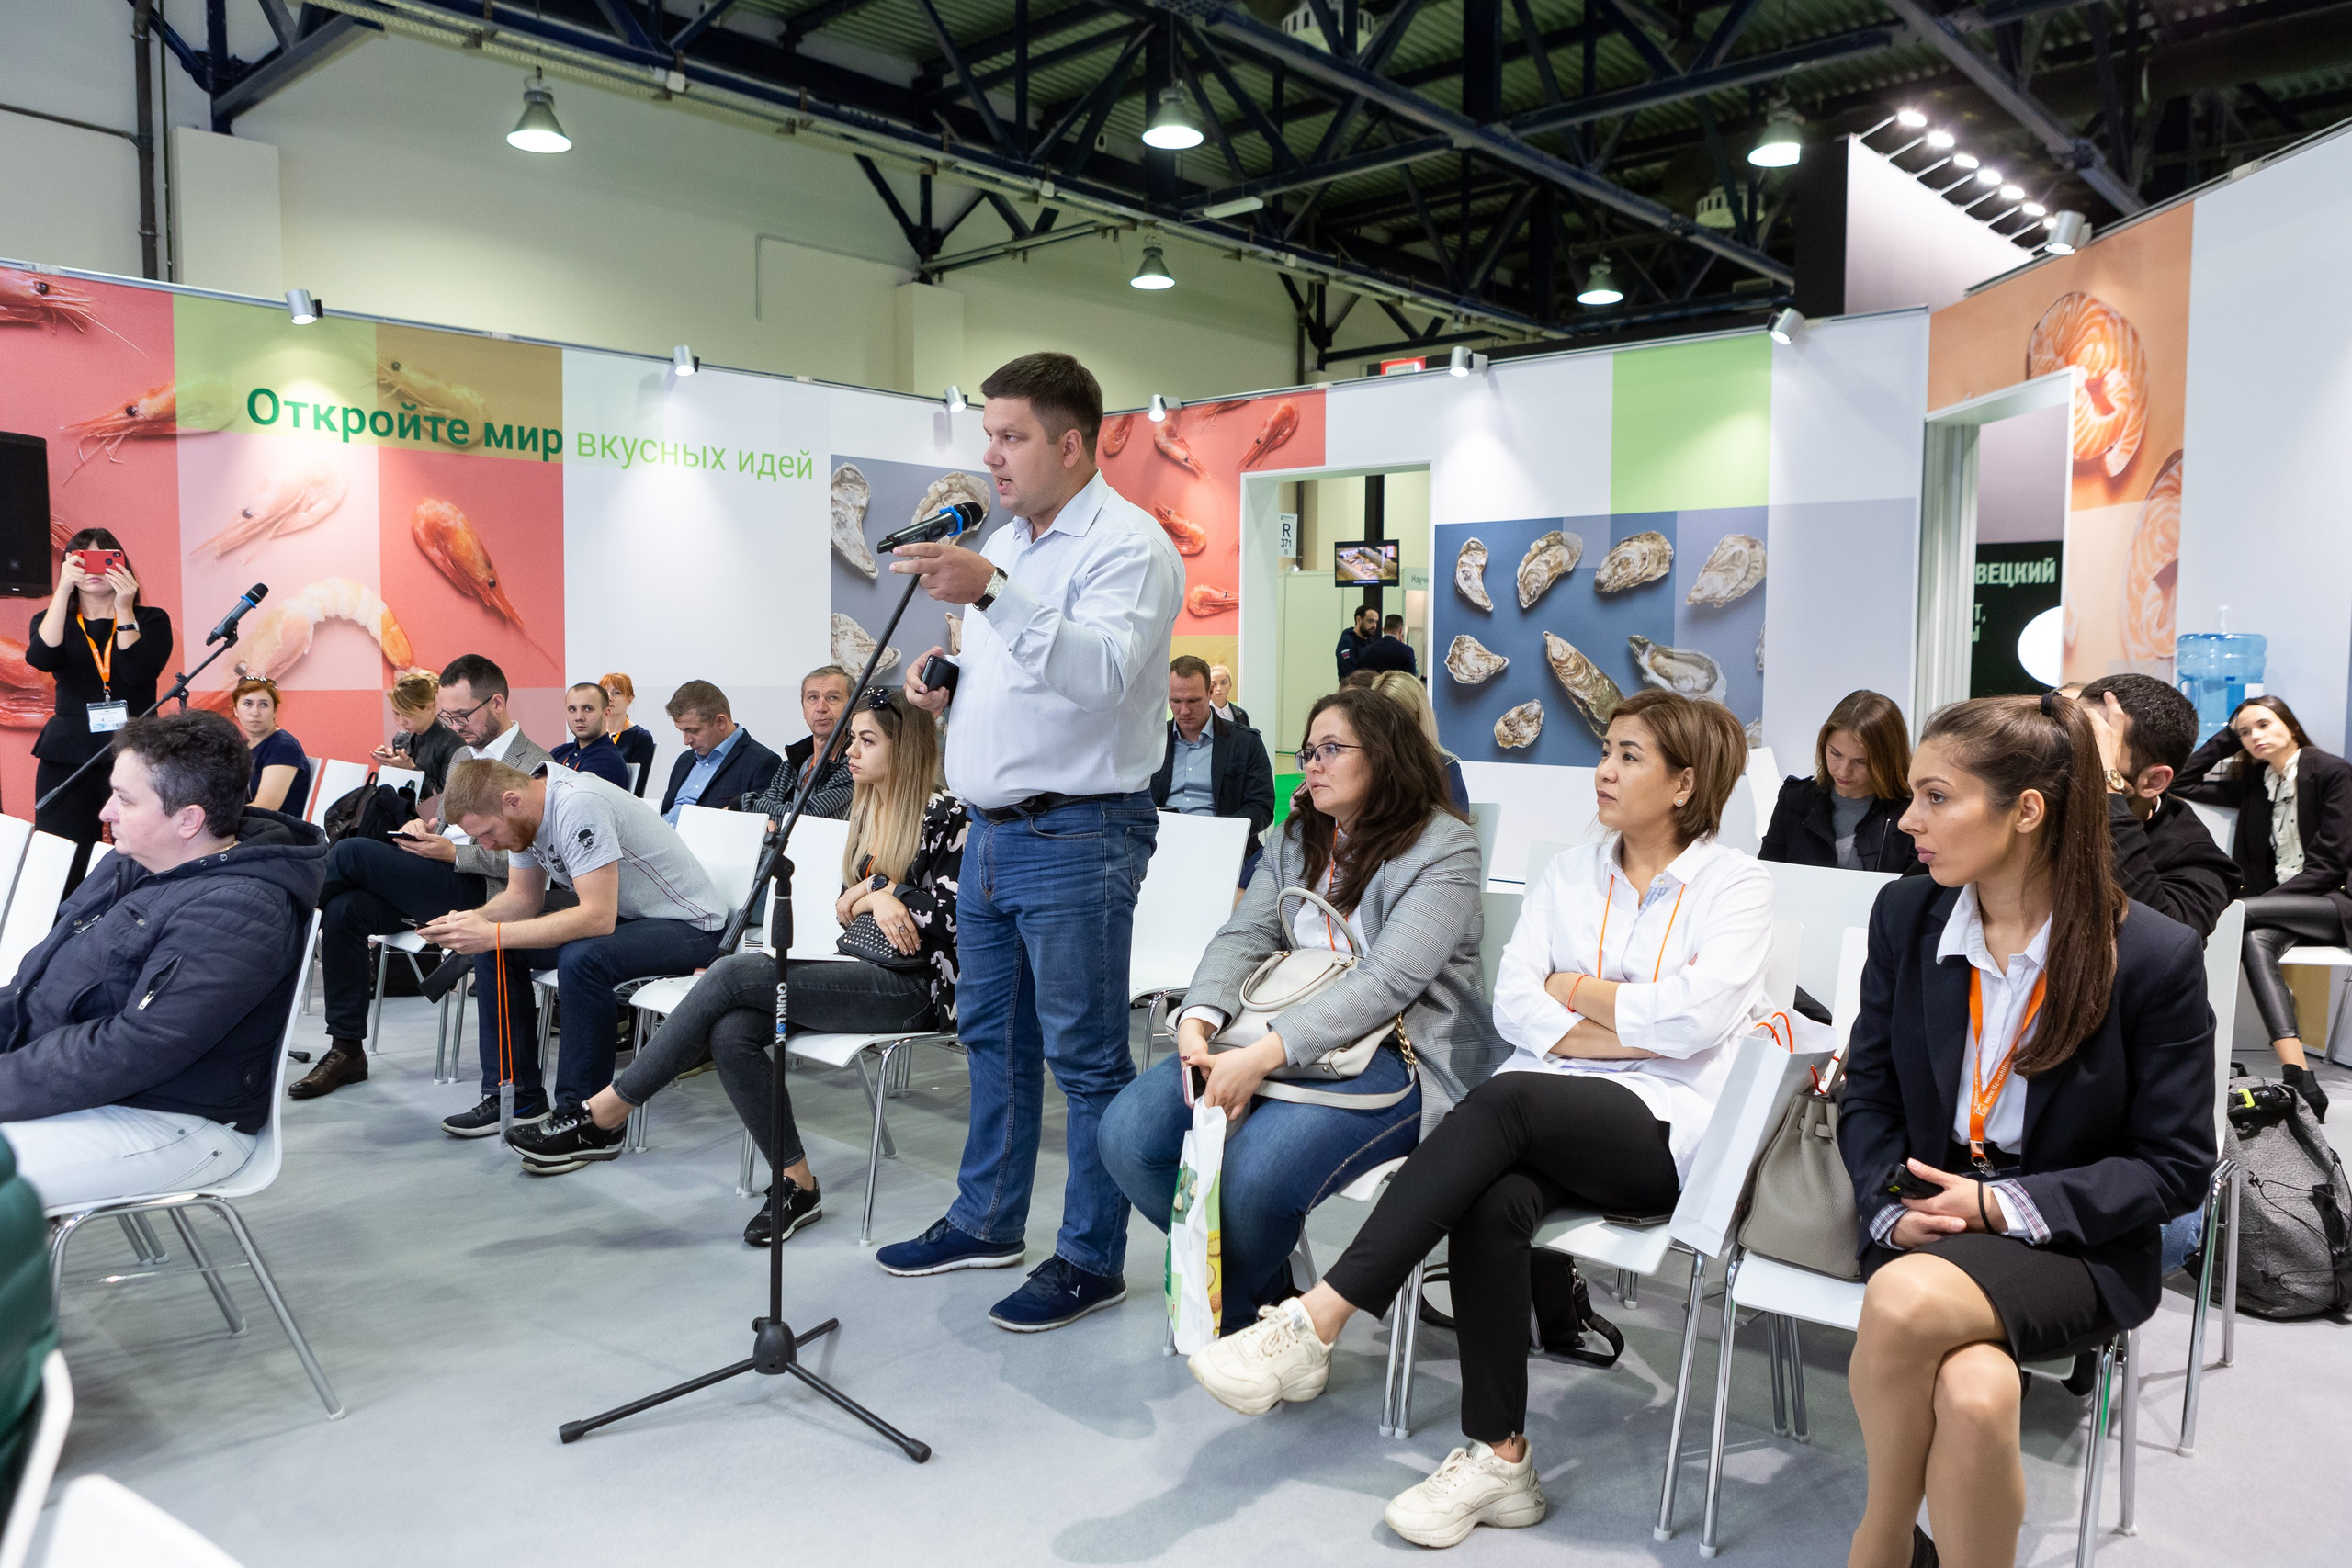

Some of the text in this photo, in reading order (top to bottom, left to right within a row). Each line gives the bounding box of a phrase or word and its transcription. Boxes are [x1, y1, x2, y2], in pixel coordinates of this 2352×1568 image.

[247, 388, 813, 482] Откройте мир вкусных идей
[1283, 523, 1291, 537] R
[1281, 538, 1291, 548] 371
